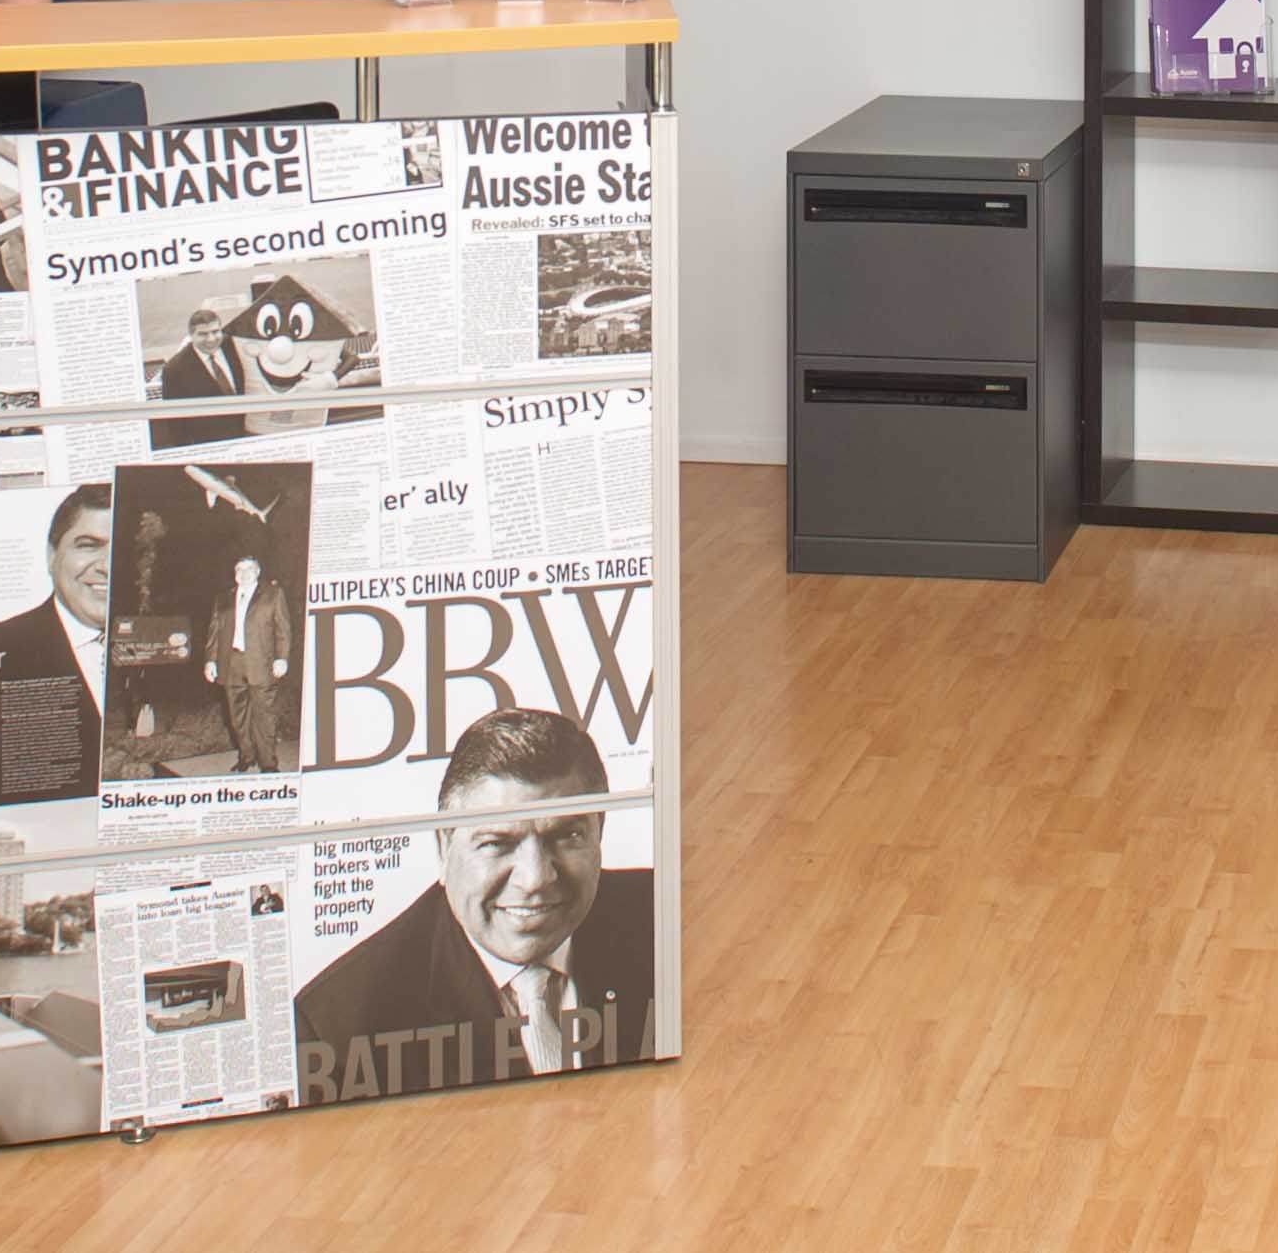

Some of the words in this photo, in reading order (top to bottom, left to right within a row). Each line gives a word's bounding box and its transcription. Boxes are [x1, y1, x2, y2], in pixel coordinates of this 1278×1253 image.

[462, 118, 632, 155] Welcome
[36, 127, 299, 182] BANKING
[87, 157, 303, 217] FINANCE
[461, 161, 586, 210] Aussie
[472, 216, 545, 231] Revealed:
[548, 214, 580, 227] SFS
[583, 213, 605, 226] set
[609, 212, 623, 225] to
[48, 236, 204, 284] Symond's
[215, 222, 324, 259] second
[336, 211, 448, 244] coming
[483, 389, 611, 428] Simply
[424, 481, 469, 506] ally
[412, 572, 467, 596] CHINA
[472, 567, 521, 591] COUP
[545, 562, 590, 584] SMEs
[101, 790, 187, 809] Shake-up
[190, 789, 213, 805] on
[217, 787, 245, 803] the
[249, 784, 298, 801] cards
[314, 841, 338, 860] big
[341, 834, 411, 856] mortgage
[313, 858, 370, 877] brokers
[374, 854, 401, 870] will
[313, 880, 348, 899] fight
[351, 876, 375, 893] the
[313, 895, 375, 921] property
[313, 917, 360, 938] slump
